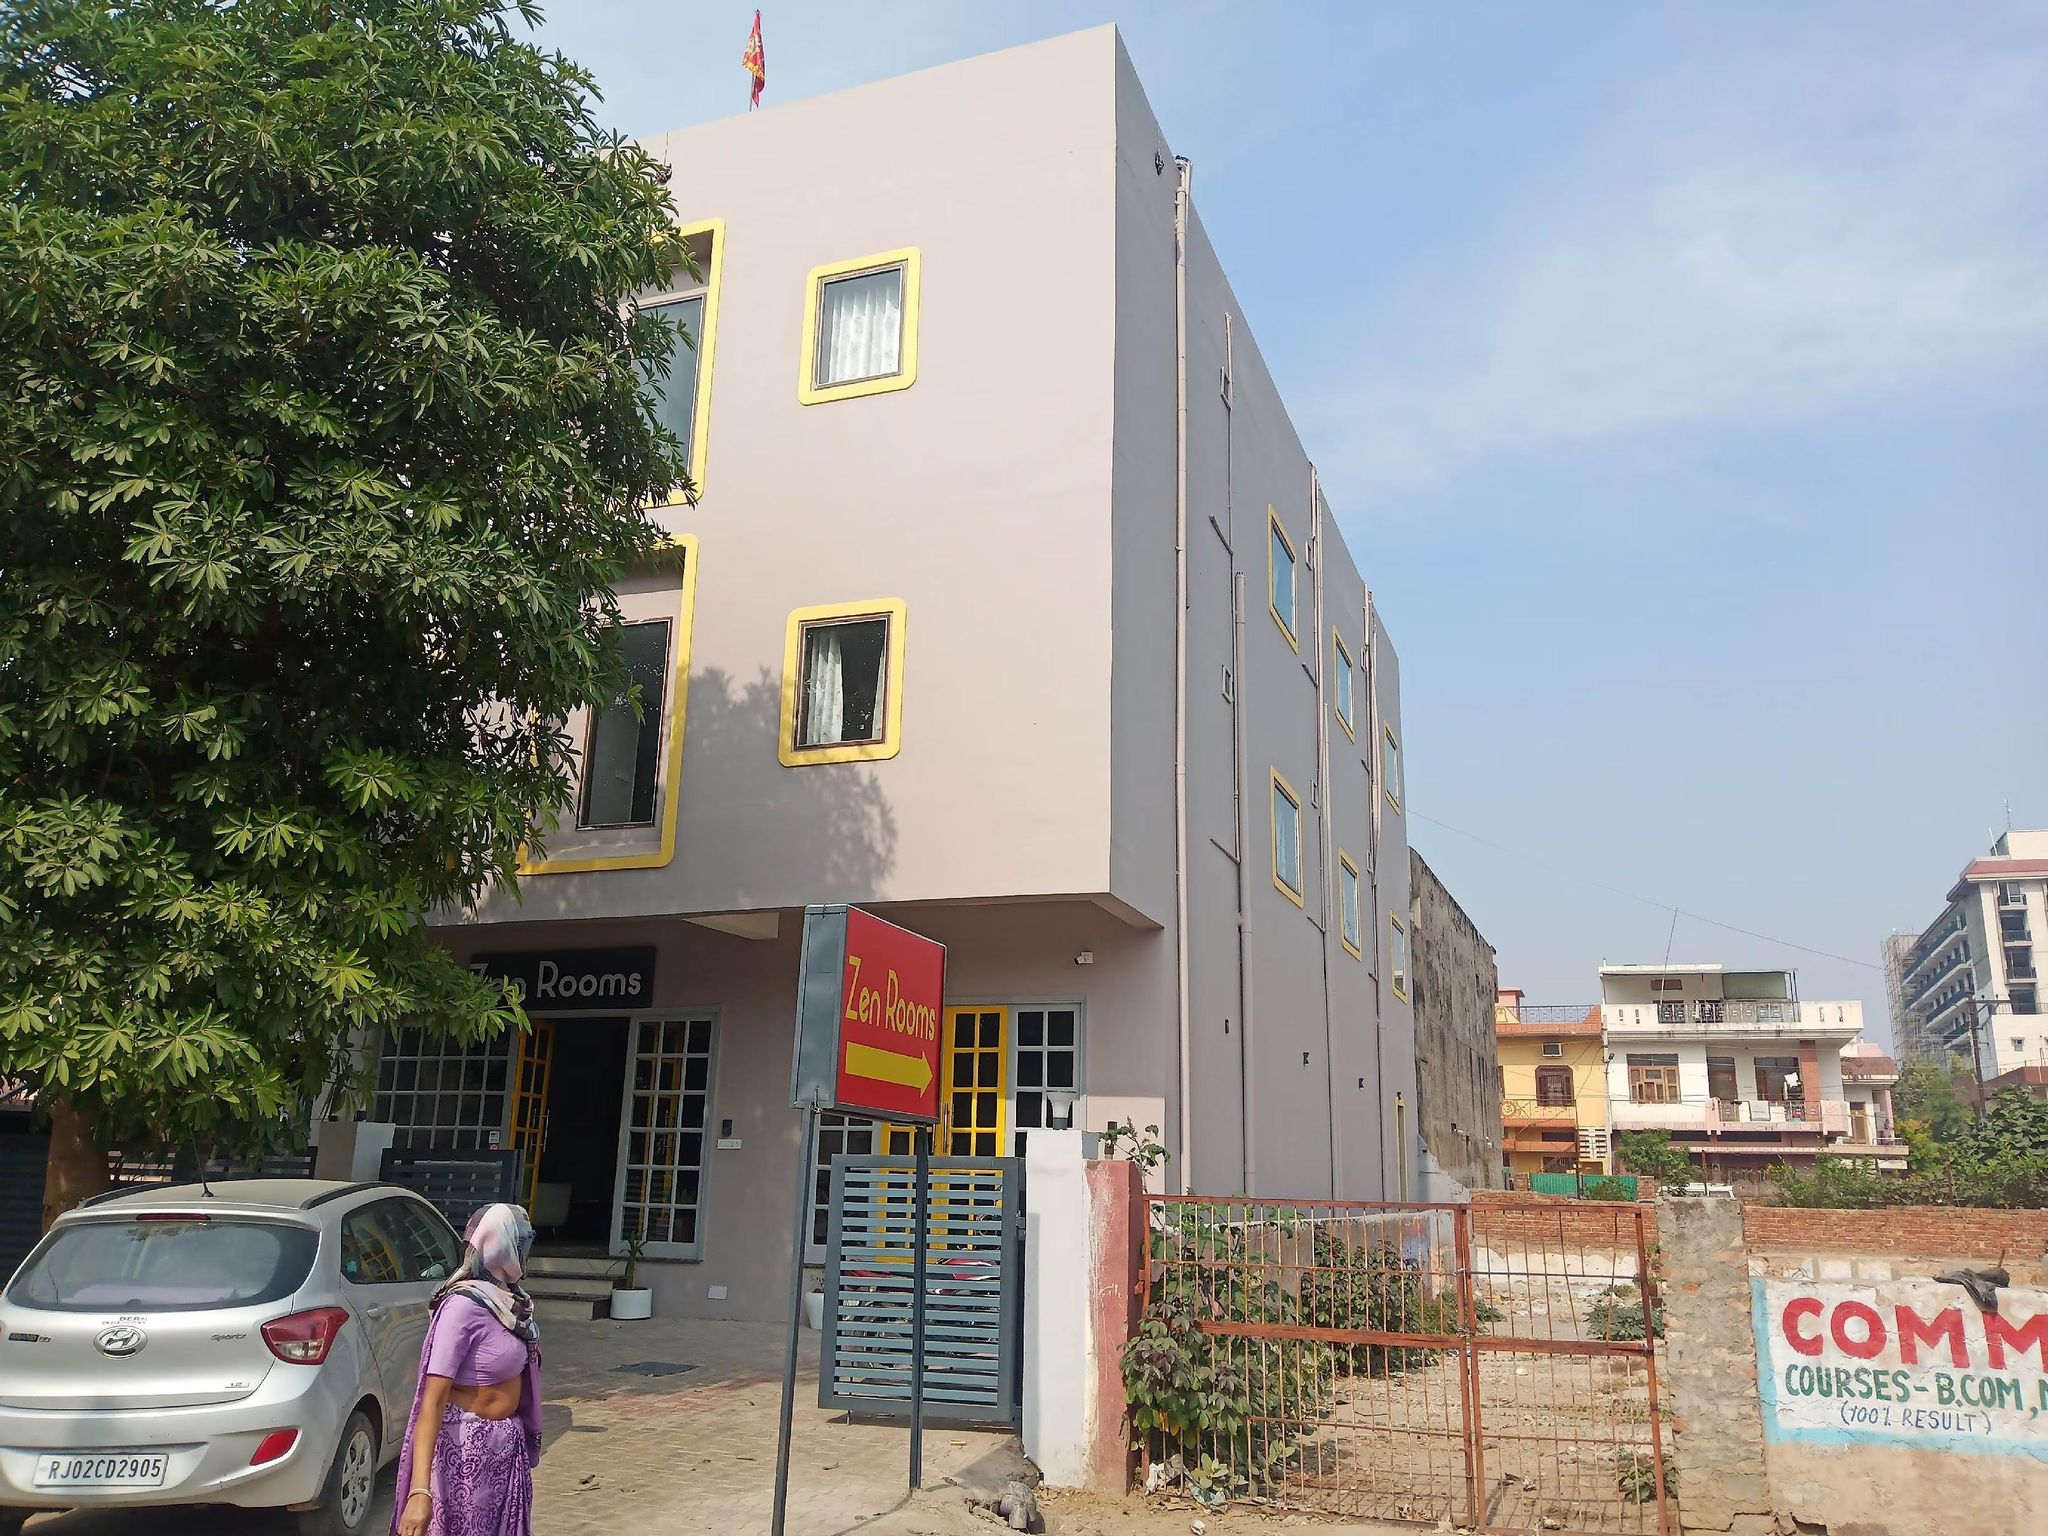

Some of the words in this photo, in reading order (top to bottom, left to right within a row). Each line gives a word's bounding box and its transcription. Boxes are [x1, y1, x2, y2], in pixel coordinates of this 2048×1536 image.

[536, 960, 642, 998] Rooms
[845, 955, 881, 1027] Zen
[885, 969, 936, 1041] Rooms
[1782, 1297, 2048, 1374] COMM
[48, 1459, 162, 1479] RJ02CD2905
